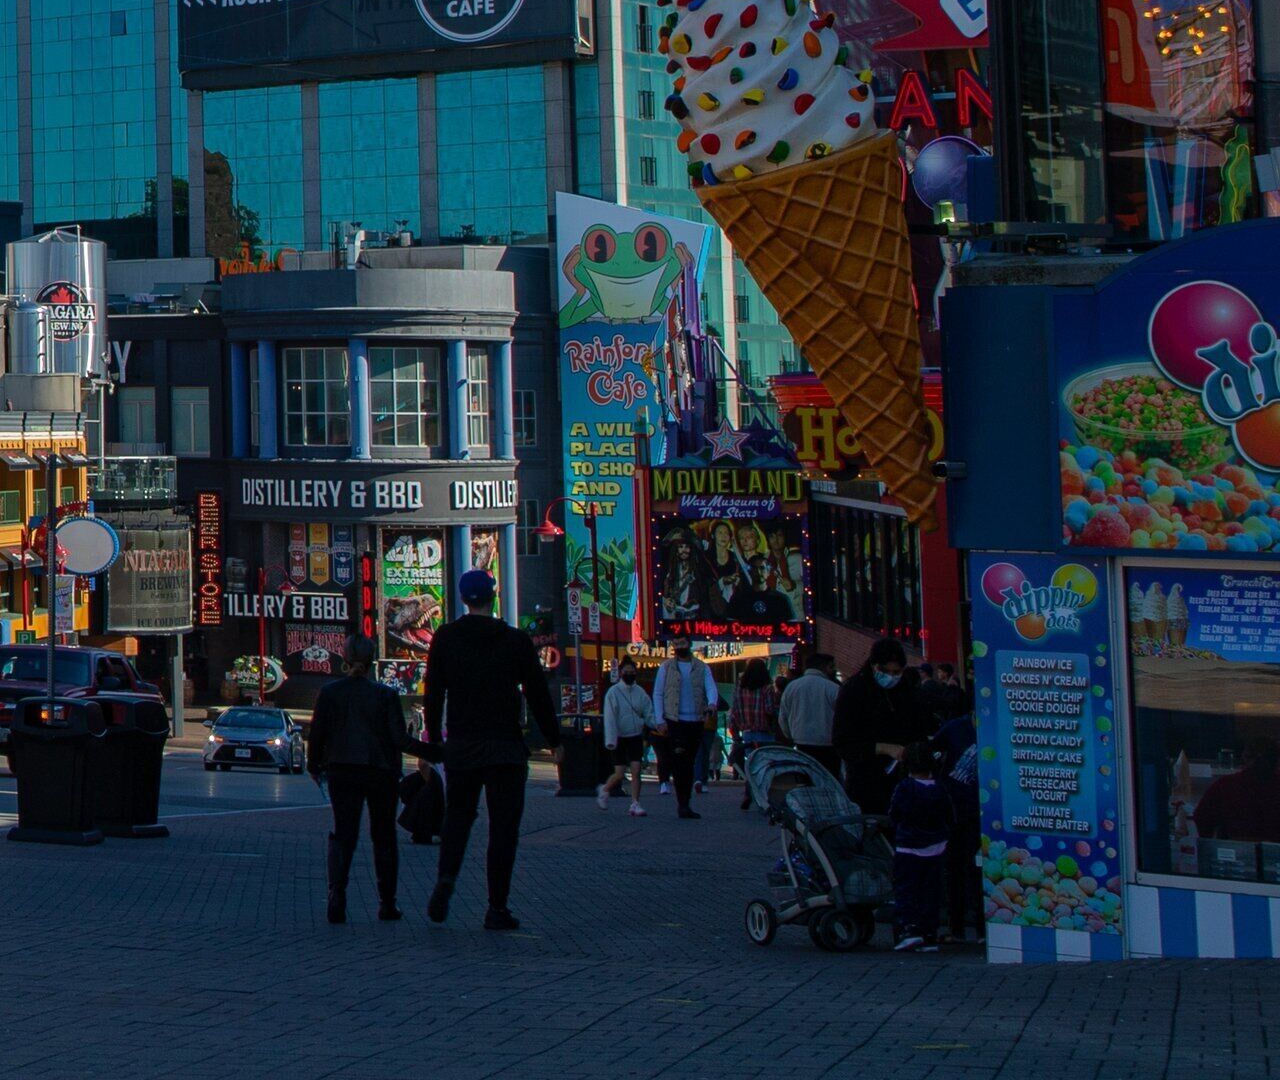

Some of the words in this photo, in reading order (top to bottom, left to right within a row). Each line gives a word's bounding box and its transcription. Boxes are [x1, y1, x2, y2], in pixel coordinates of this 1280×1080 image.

[569, 422, 588, 437] A
[571, 461, 594, 476] TO
[599, 462, 636, 477] SHO
[242, 477, 342, 508] DISTILLERY
[350, 480, 367, 508] &
[372, 480, 424, 509] BBQ
[572, 481, 621, 496] AND
[653, 470, 803, 502] MOVIELAND
[572, 501, 616, 516] EAT
[681, 494, 706, 508] Wax
[707, 494, 759, 508] Museum
[760, 495, 776, 511] of
[698, 507, 720, 518] The
[721, 507, 758, 519] Stars
[200, 493, 219, 549] BEER
[384, 535, 442, 568] 4D
[386, 568, 442, 578] EXTREME
[386, 577, 423, 585] MOTION
[200, 553, 220, 625] STORE
[293, 596, 305, 619] &
[311, 596, 349, 620] BBQ
[694, 622, 729, 636] Miley
[732, 623, 772, 637] Cyrus
[627, 641, 675, 658] GAME
[1013, 657, 1057, 669] RAINBOW
[1058, 659, 1072, 669] ICE
[1000, 672, 1040, 684] COOKIES
[1042, 674, 1052, 685] N'
[1054, 675, 1086, 686] CREAM
[1006, 689, 1059, 701] CHOCOLATE
[1061, 691, 1083, 702] CHIP
[1009, 701, 1044, 712] COOKIE
[1046, 702, 1080, 714] DOUGH
[1013, 717, 1052, 729] BANANA
[1054, 719, 1078, 730] SPLIT
[1010, 732, 1047, 745] COTTON
[1050, 735, 1083, 747] CANDY
[1012, 749, 1056, 760] BIRTHDAY
[1057, 752, 1083, 763] CAKE
[1018, 765, 1077, 779] STRAWBERRY
[1019, 777, 1078, 791] CHEESECAKE
[1031, 790, 1068, 801] YOGURT
[1028, 805, 1071, 818] ULTIMATE
[1011, 816, 1054, 828] BROWNIE
[1055, 819, 1089, 831] BATTER
